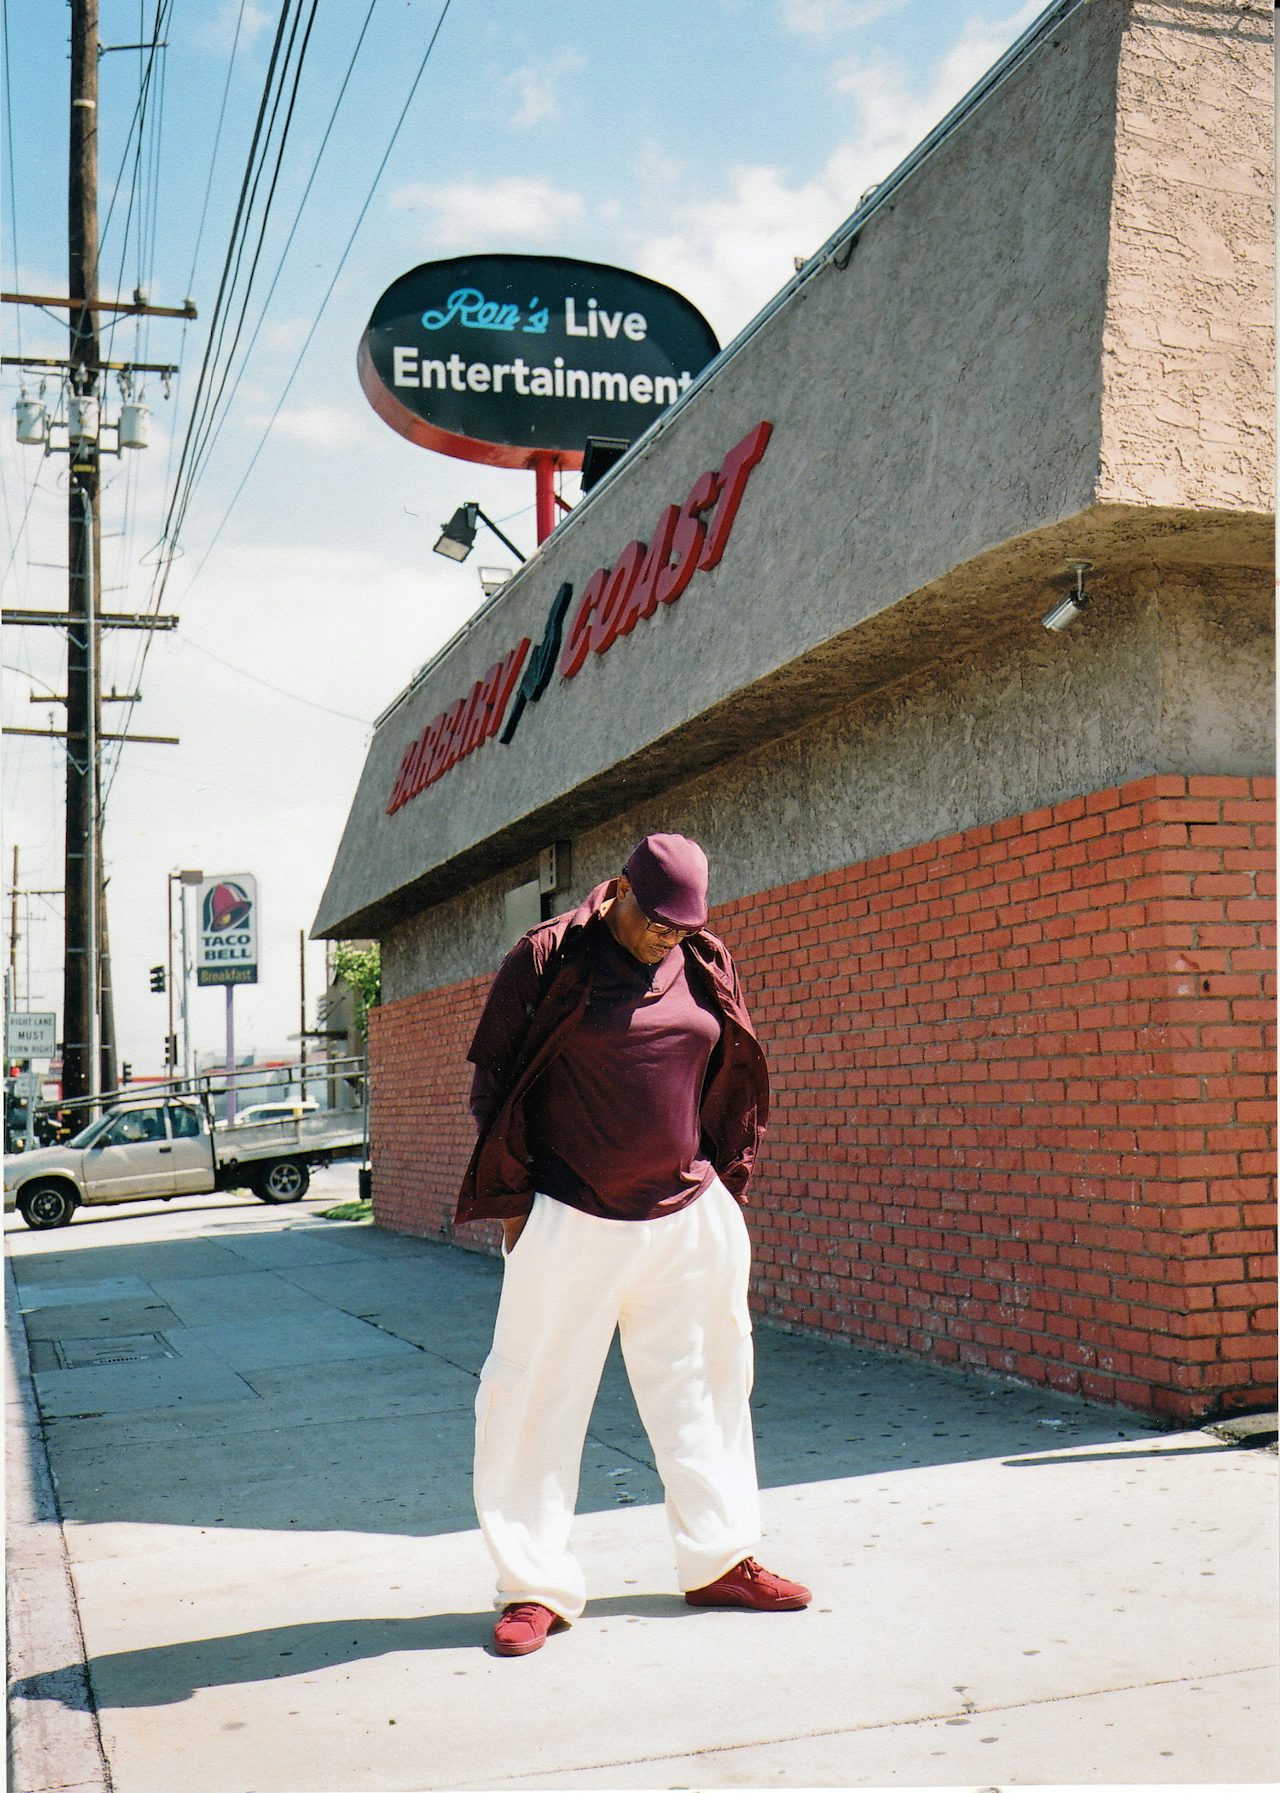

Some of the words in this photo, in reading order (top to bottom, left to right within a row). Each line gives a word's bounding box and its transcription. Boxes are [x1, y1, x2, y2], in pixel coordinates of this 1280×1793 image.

[421, 288, 549, 334] Ron's
[565, 296, 648, 341] Live
[393, 346, 694, 405] Entertainment
[558, 420, 774, 679] COAST
[202, 935, 251, 947] TACO
[204, 948, 252, 960] BELL
[201, 968, 251, 983] Breakfast
[18, 1031, 44, 1040] MUST
[10, 1045, 29, 1053] TURN
[31, 1045, 53, 1053] RIGHT
